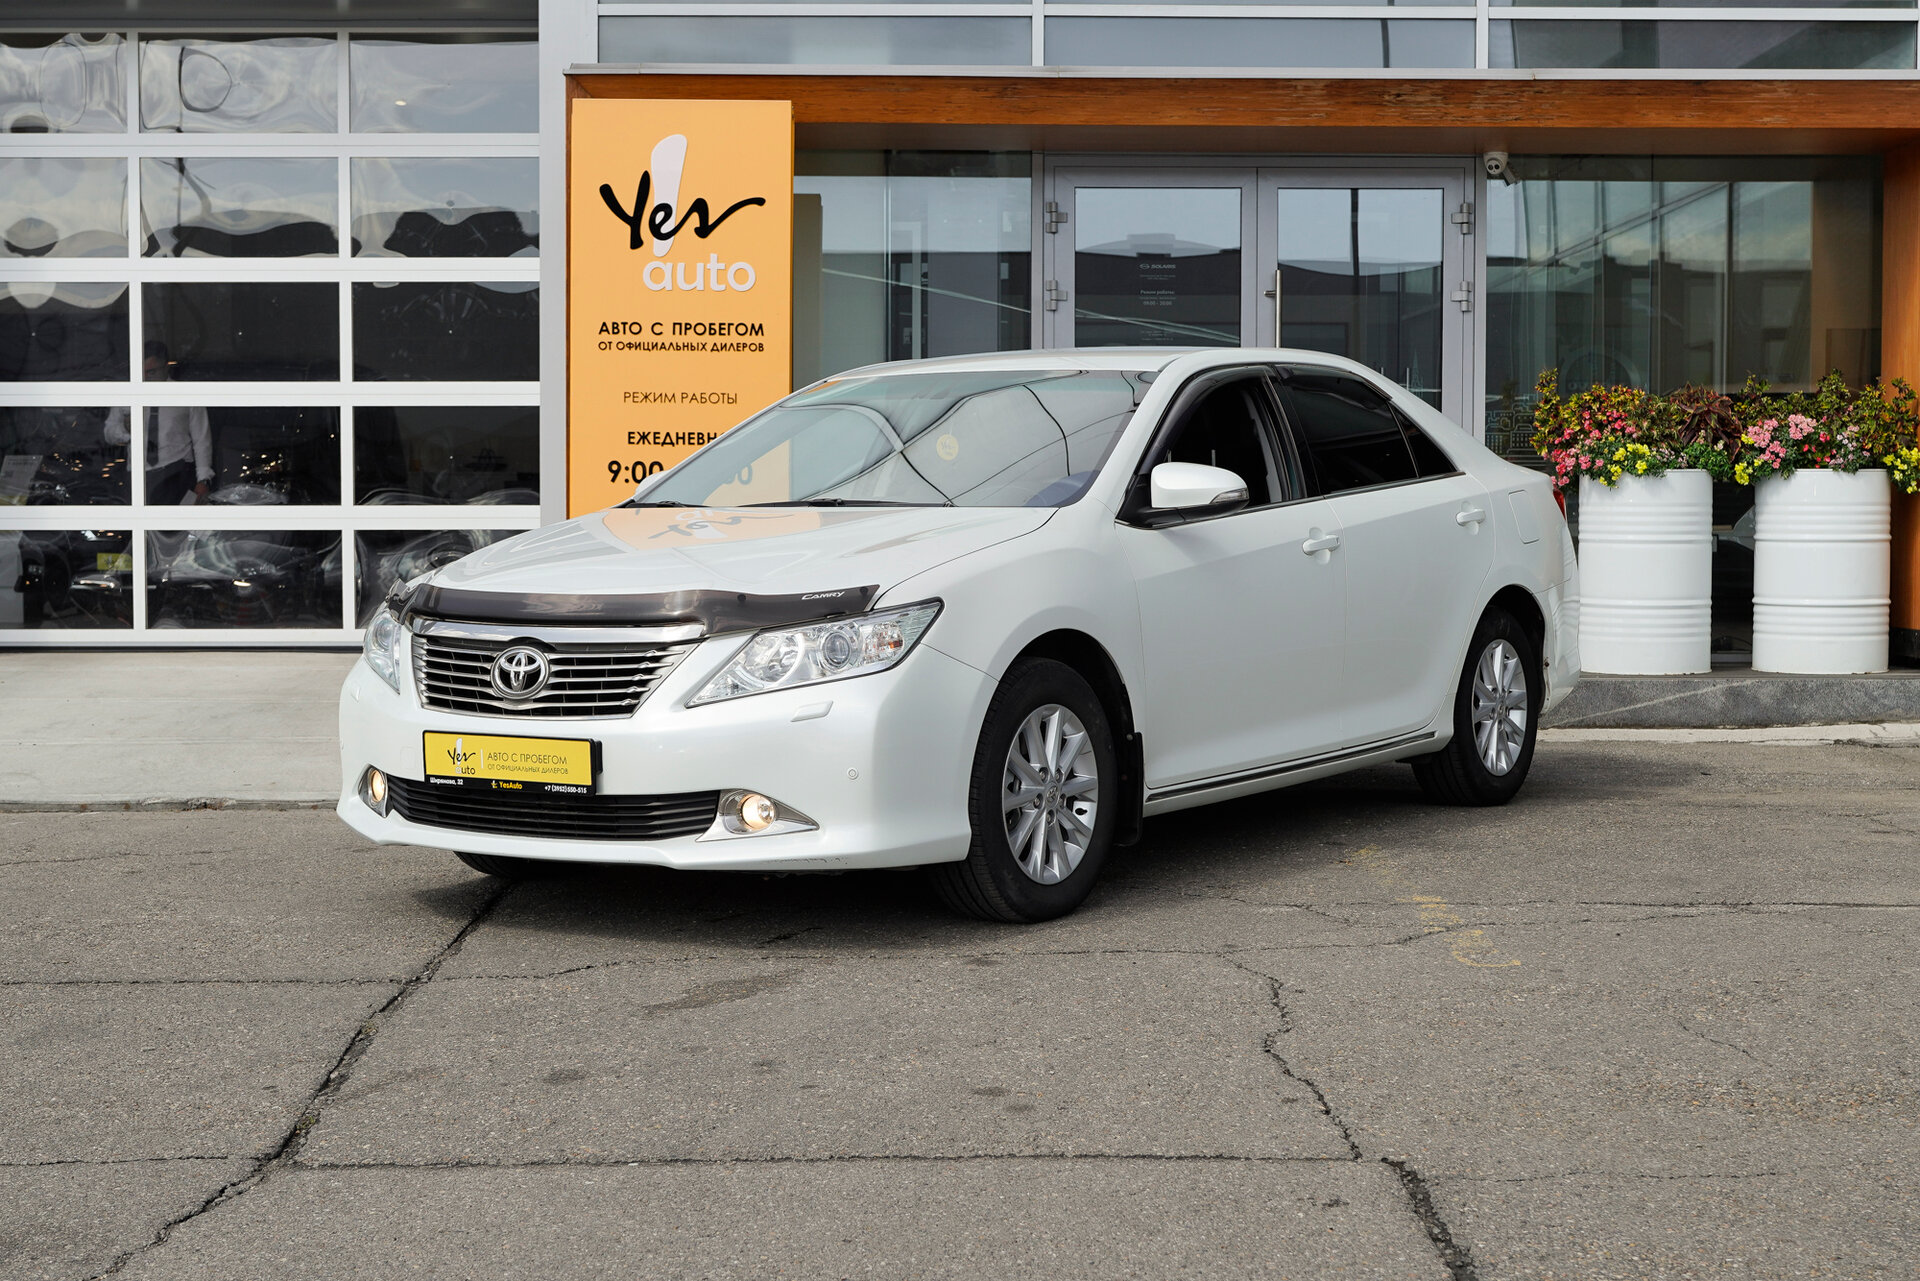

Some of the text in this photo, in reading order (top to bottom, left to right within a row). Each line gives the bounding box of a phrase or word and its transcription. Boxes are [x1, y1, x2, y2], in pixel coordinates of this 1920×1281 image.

[599, 170, 766, 250] Yes
[643, 253, 756, 292] auto
[598, 321, 765, 337] АВТО С ПРОБЕГОМ
[598, 341, 765, 353] ОТ ОФИЦИАЛЬНЫХ ДИЛЕРОВ
[623, 391, 738, 404] РЕЖИМ РАБОТЫ
[627, 431, 724, 447] ЕЖЕДНЕВН
[801, 591, 845, 600] CAMRY
[447, 747, 476, 765] Yes
[487, 752, 568, 765] АВТО С ПРОБЕГОМ
[455, 765, 476, 775] auto
